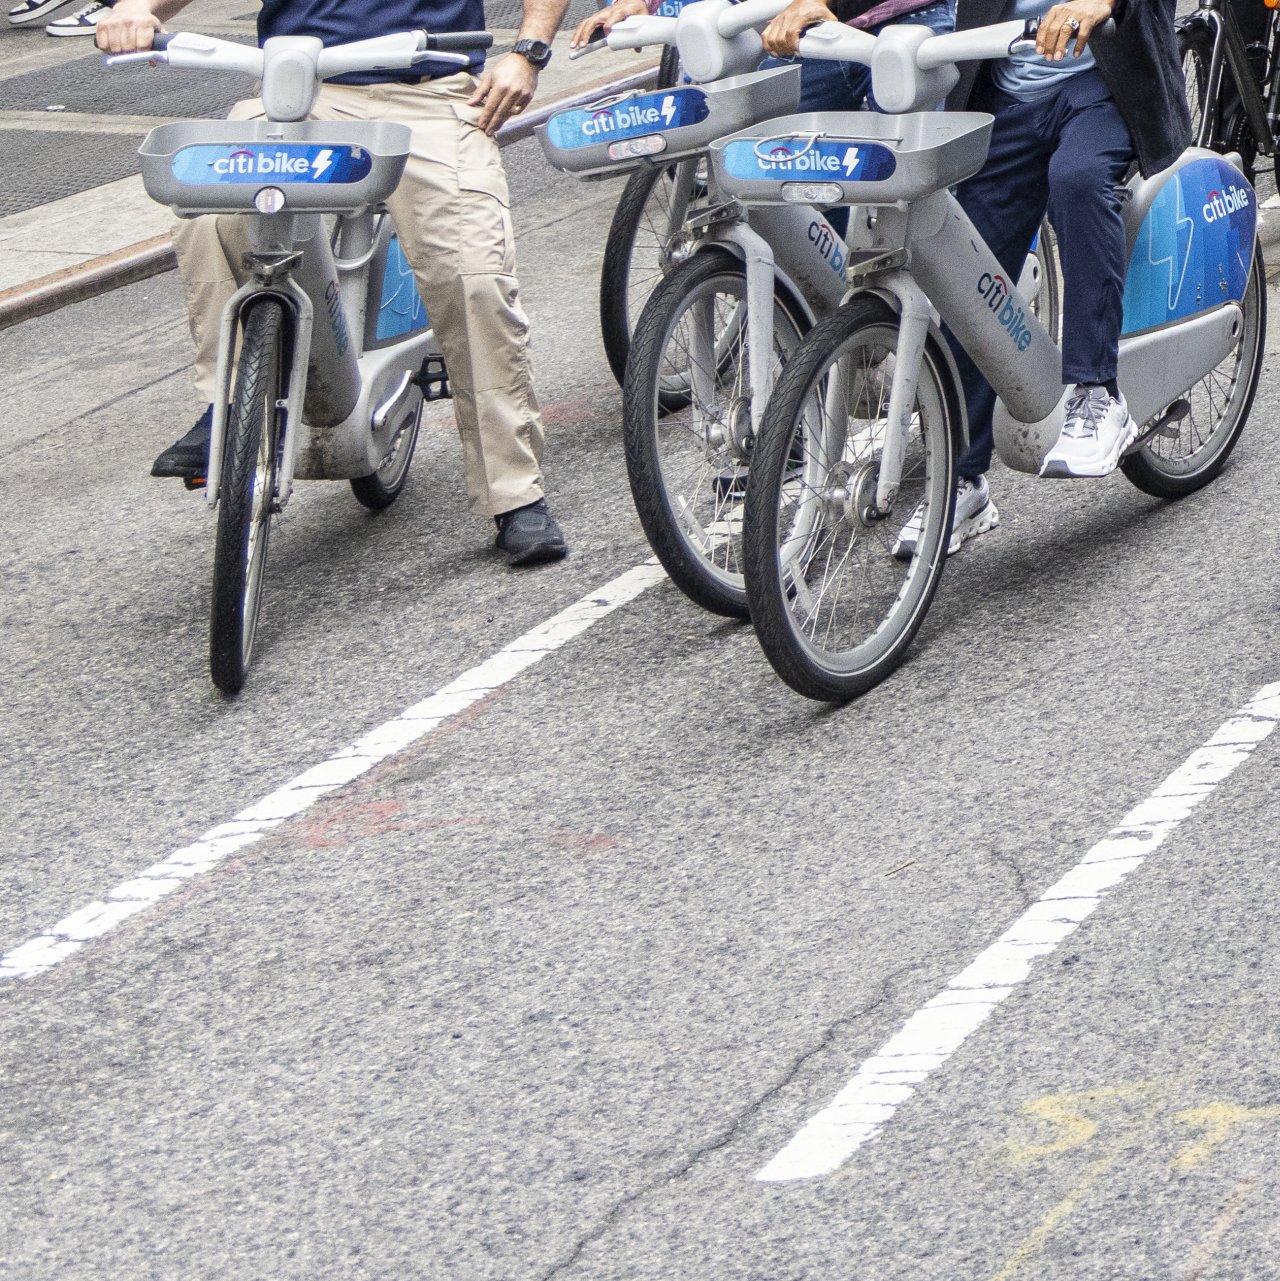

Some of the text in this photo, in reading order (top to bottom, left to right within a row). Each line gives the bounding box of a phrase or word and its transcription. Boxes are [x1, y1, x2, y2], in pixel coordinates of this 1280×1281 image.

[582, 100, 660, 136] citi bike
[214, 151, 309, 174] citi bike
[758, 147, 840, 171] citi bike
[1203, 186, 1249, 223] citi bike
[807, 222, 834, 257] citi
[977, 272, 1032, 353] citi bike
